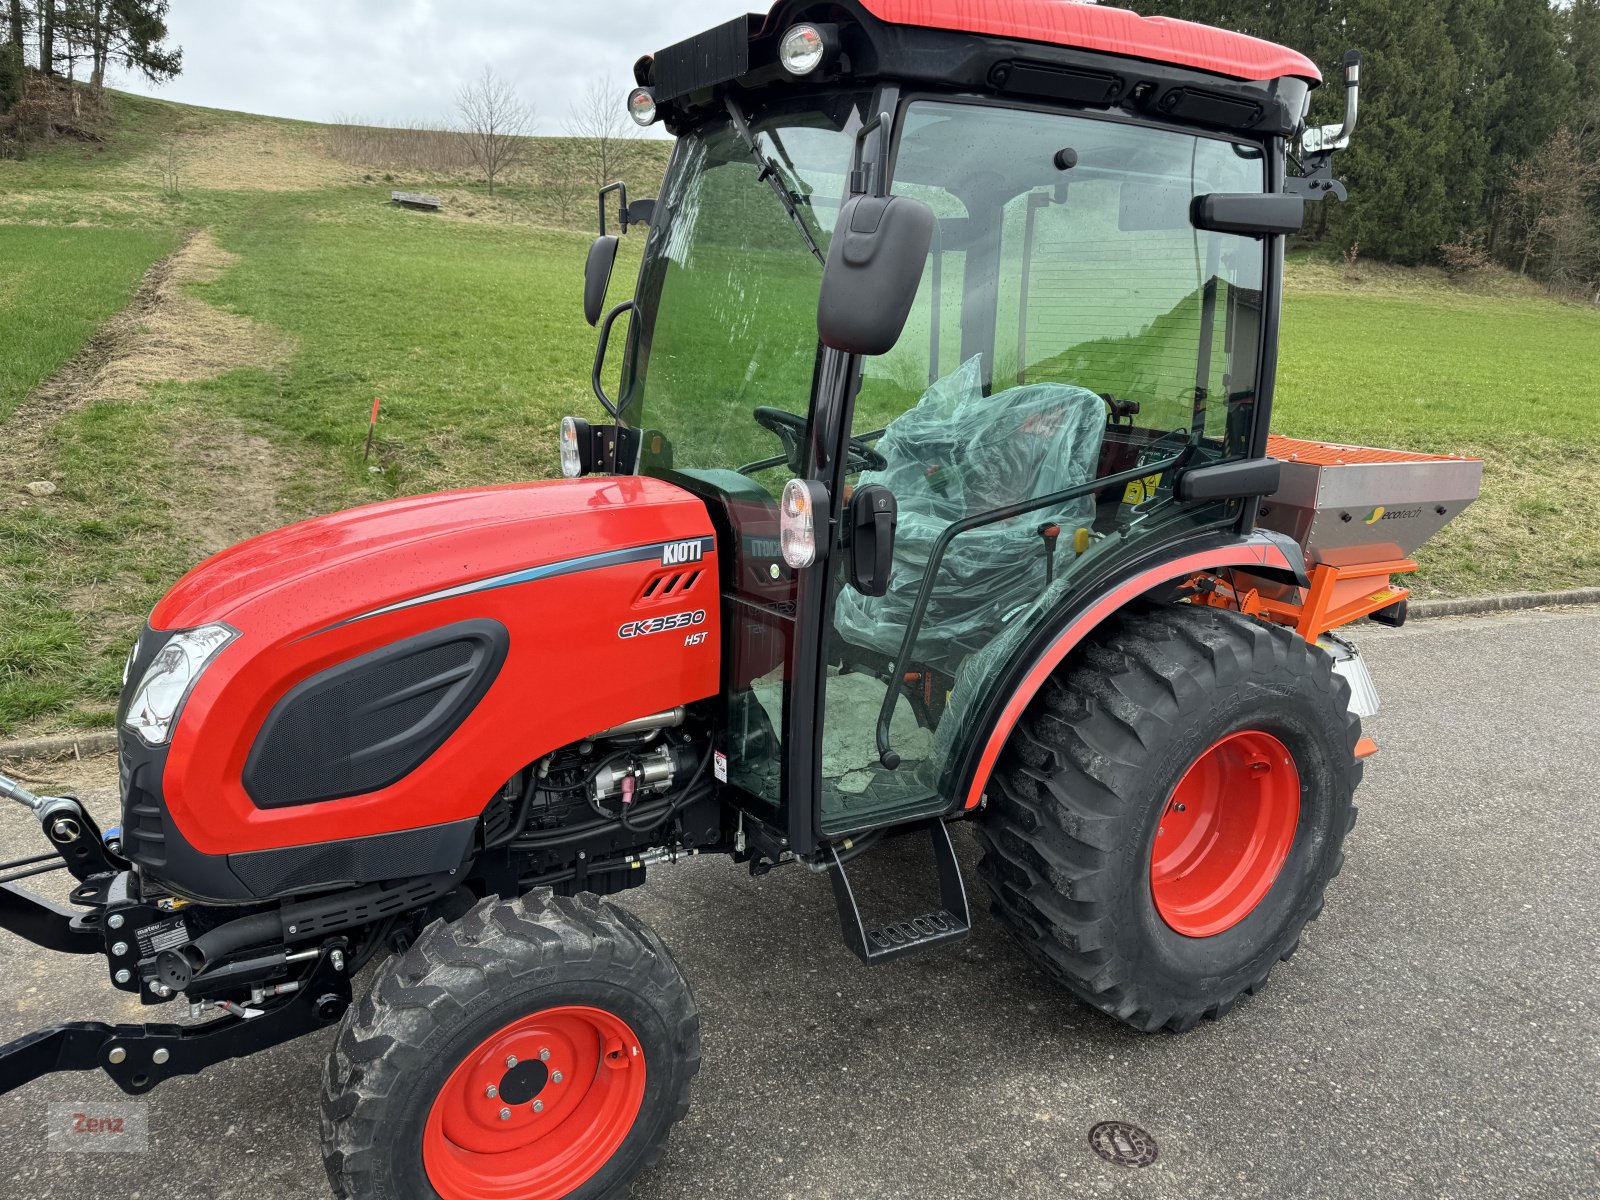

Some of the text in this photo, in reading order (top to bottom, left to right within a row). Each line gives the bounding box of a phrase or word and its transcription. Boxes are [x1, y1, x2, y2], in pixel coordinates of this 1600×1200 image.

[1381, 507, 1422, 520] ecotech
[662, 540, 702, 566] KIOTI
[618, 609, 706, 639] CK3530
[684, 631, 709, 646] HST
